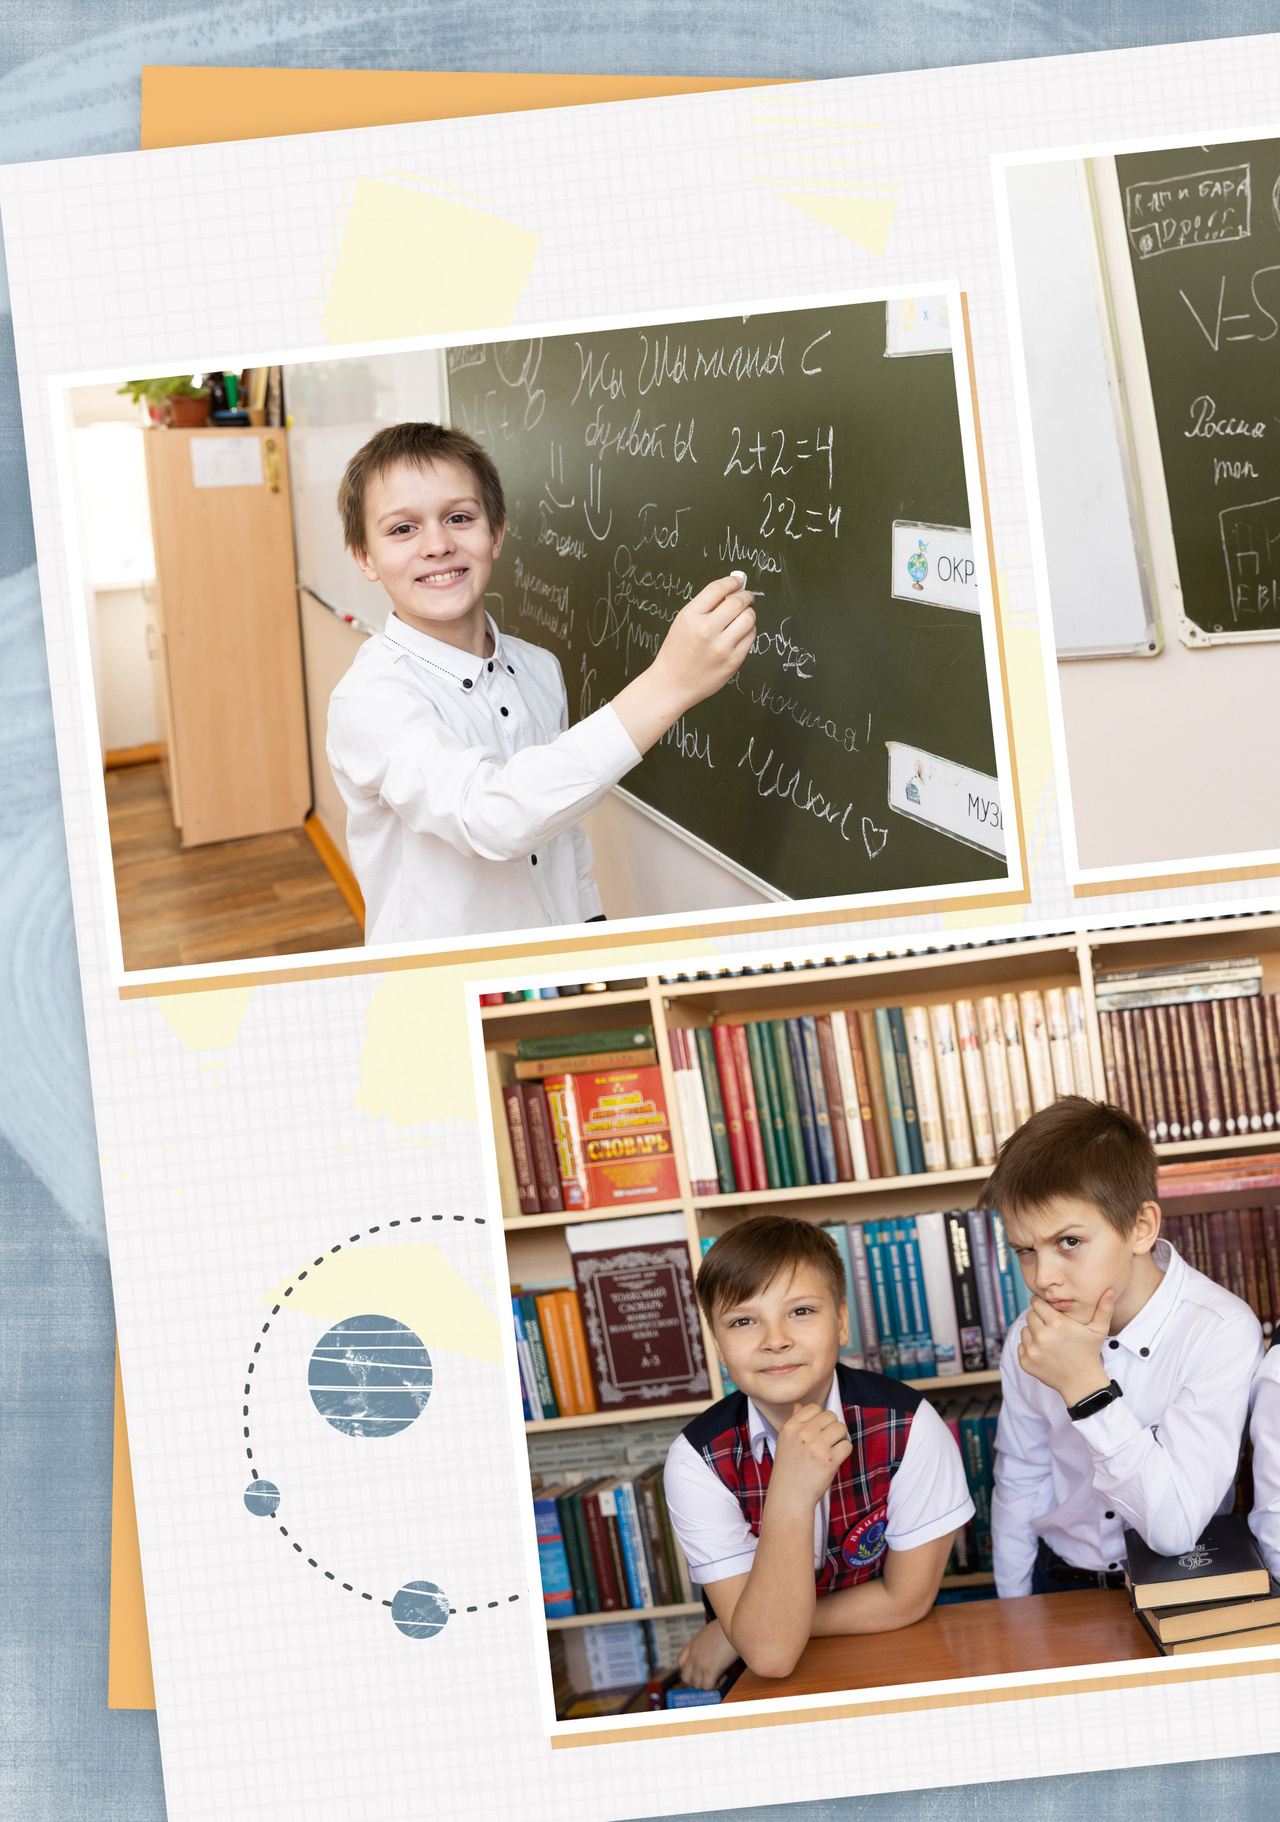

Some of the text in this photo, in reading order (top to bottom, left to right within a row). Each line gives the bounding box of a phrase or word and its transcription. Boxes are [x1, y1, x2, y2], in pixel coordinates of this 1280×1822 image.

[1184, 395, 1266, 438] Россия
[723, 426, 835, 490] 2+2=4
[1214, 458, 1259, 486] топ
[937, 556, 979, 587] ОКР
[587, 1133, 670, 1160] СЛОВАРЬ
[610, 1285, 668, 1303] ТОЛКОВЫЙ
[618, 1299, 664, 1314] СЛОВАРЬ
[632, 1329, 660, 1340] ЯЗЫКА
